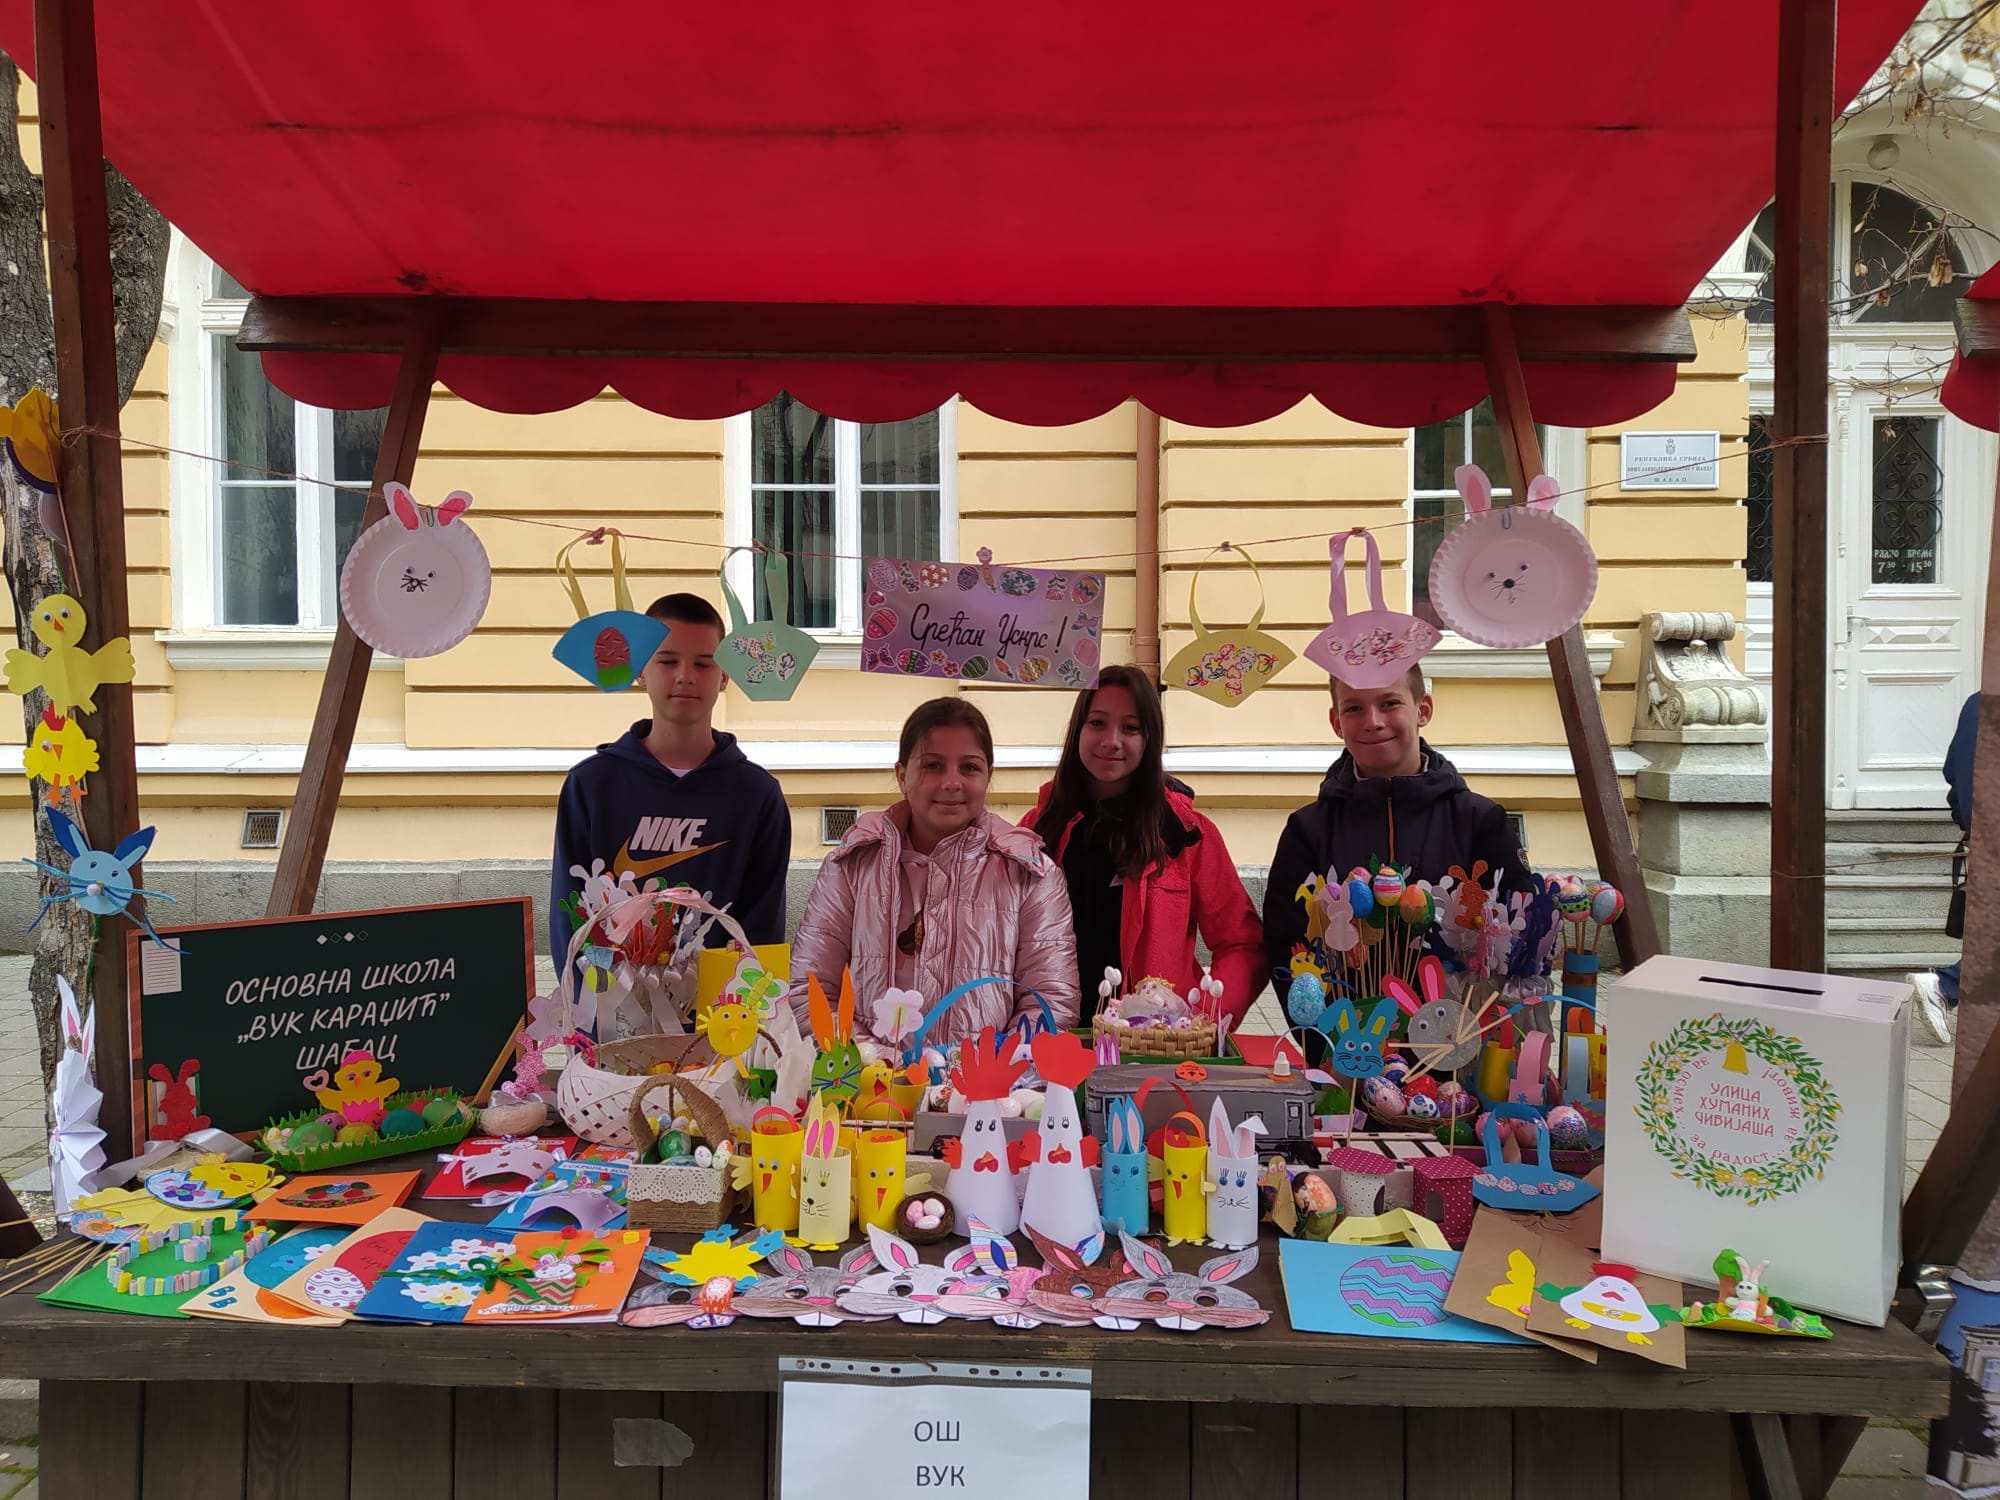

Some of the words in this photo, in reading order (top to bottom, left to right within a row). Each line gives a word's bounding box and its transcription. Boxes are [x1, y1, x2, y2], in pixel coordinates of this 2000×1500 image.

[1907, 549, 1933, 558] ВРЕМЕ
[910, 603, 986, 650] Срећан
[629, 816, 707, 851] NIKE
[225, 968, 352, 1006] ОСНОВНА
[361, 957, 456, 990] ШКОЛА
[237, 1011, 305, 1044] „ВУК
[309, 992, 451, 1032] КАРАЏИЋ”
[1692, 1056, 1710, 1070] за
[1710, 1082, 1761, 1103] УЛИЦА
[1760, 1066, 1801, 1120] живот!
[1699, 1096, 1771, 1121] ХУМАНИХ
[1694, 1111, 1774, 1138] ЧИВИЈАША
[1783, 1127, 1798, 1144] за
[1689, 1133, 1707, 1150] за
[913, 1420, 960, 1443] ОШ
[916, 1465, 965, 1488] ВУК
